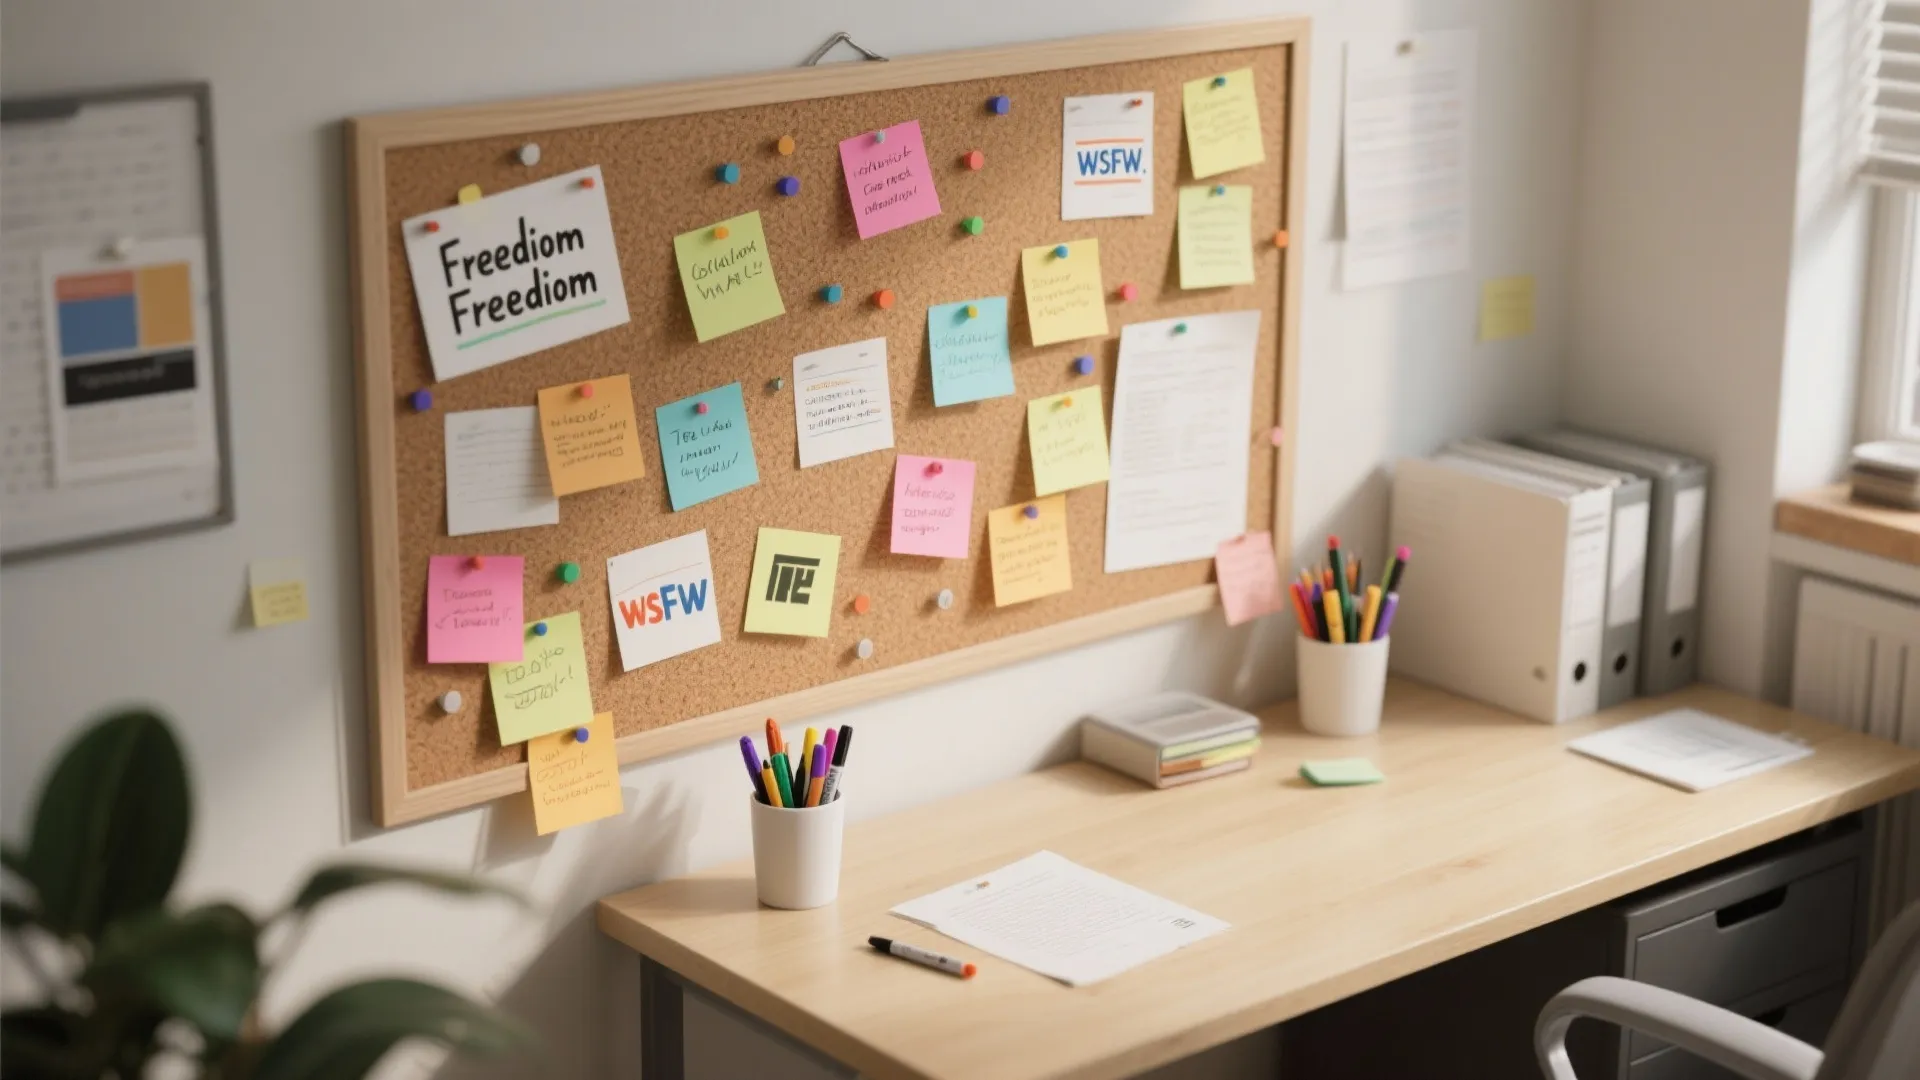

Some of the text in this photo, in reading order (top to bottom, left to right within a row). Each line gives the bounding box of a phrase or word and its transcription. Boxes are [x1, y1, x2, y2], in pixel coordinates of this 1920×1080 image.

[439, 216, 584, 287] Freediom
[448, 267, 598, 335] Freediom
[618, 578, 707, 630] WSFW
